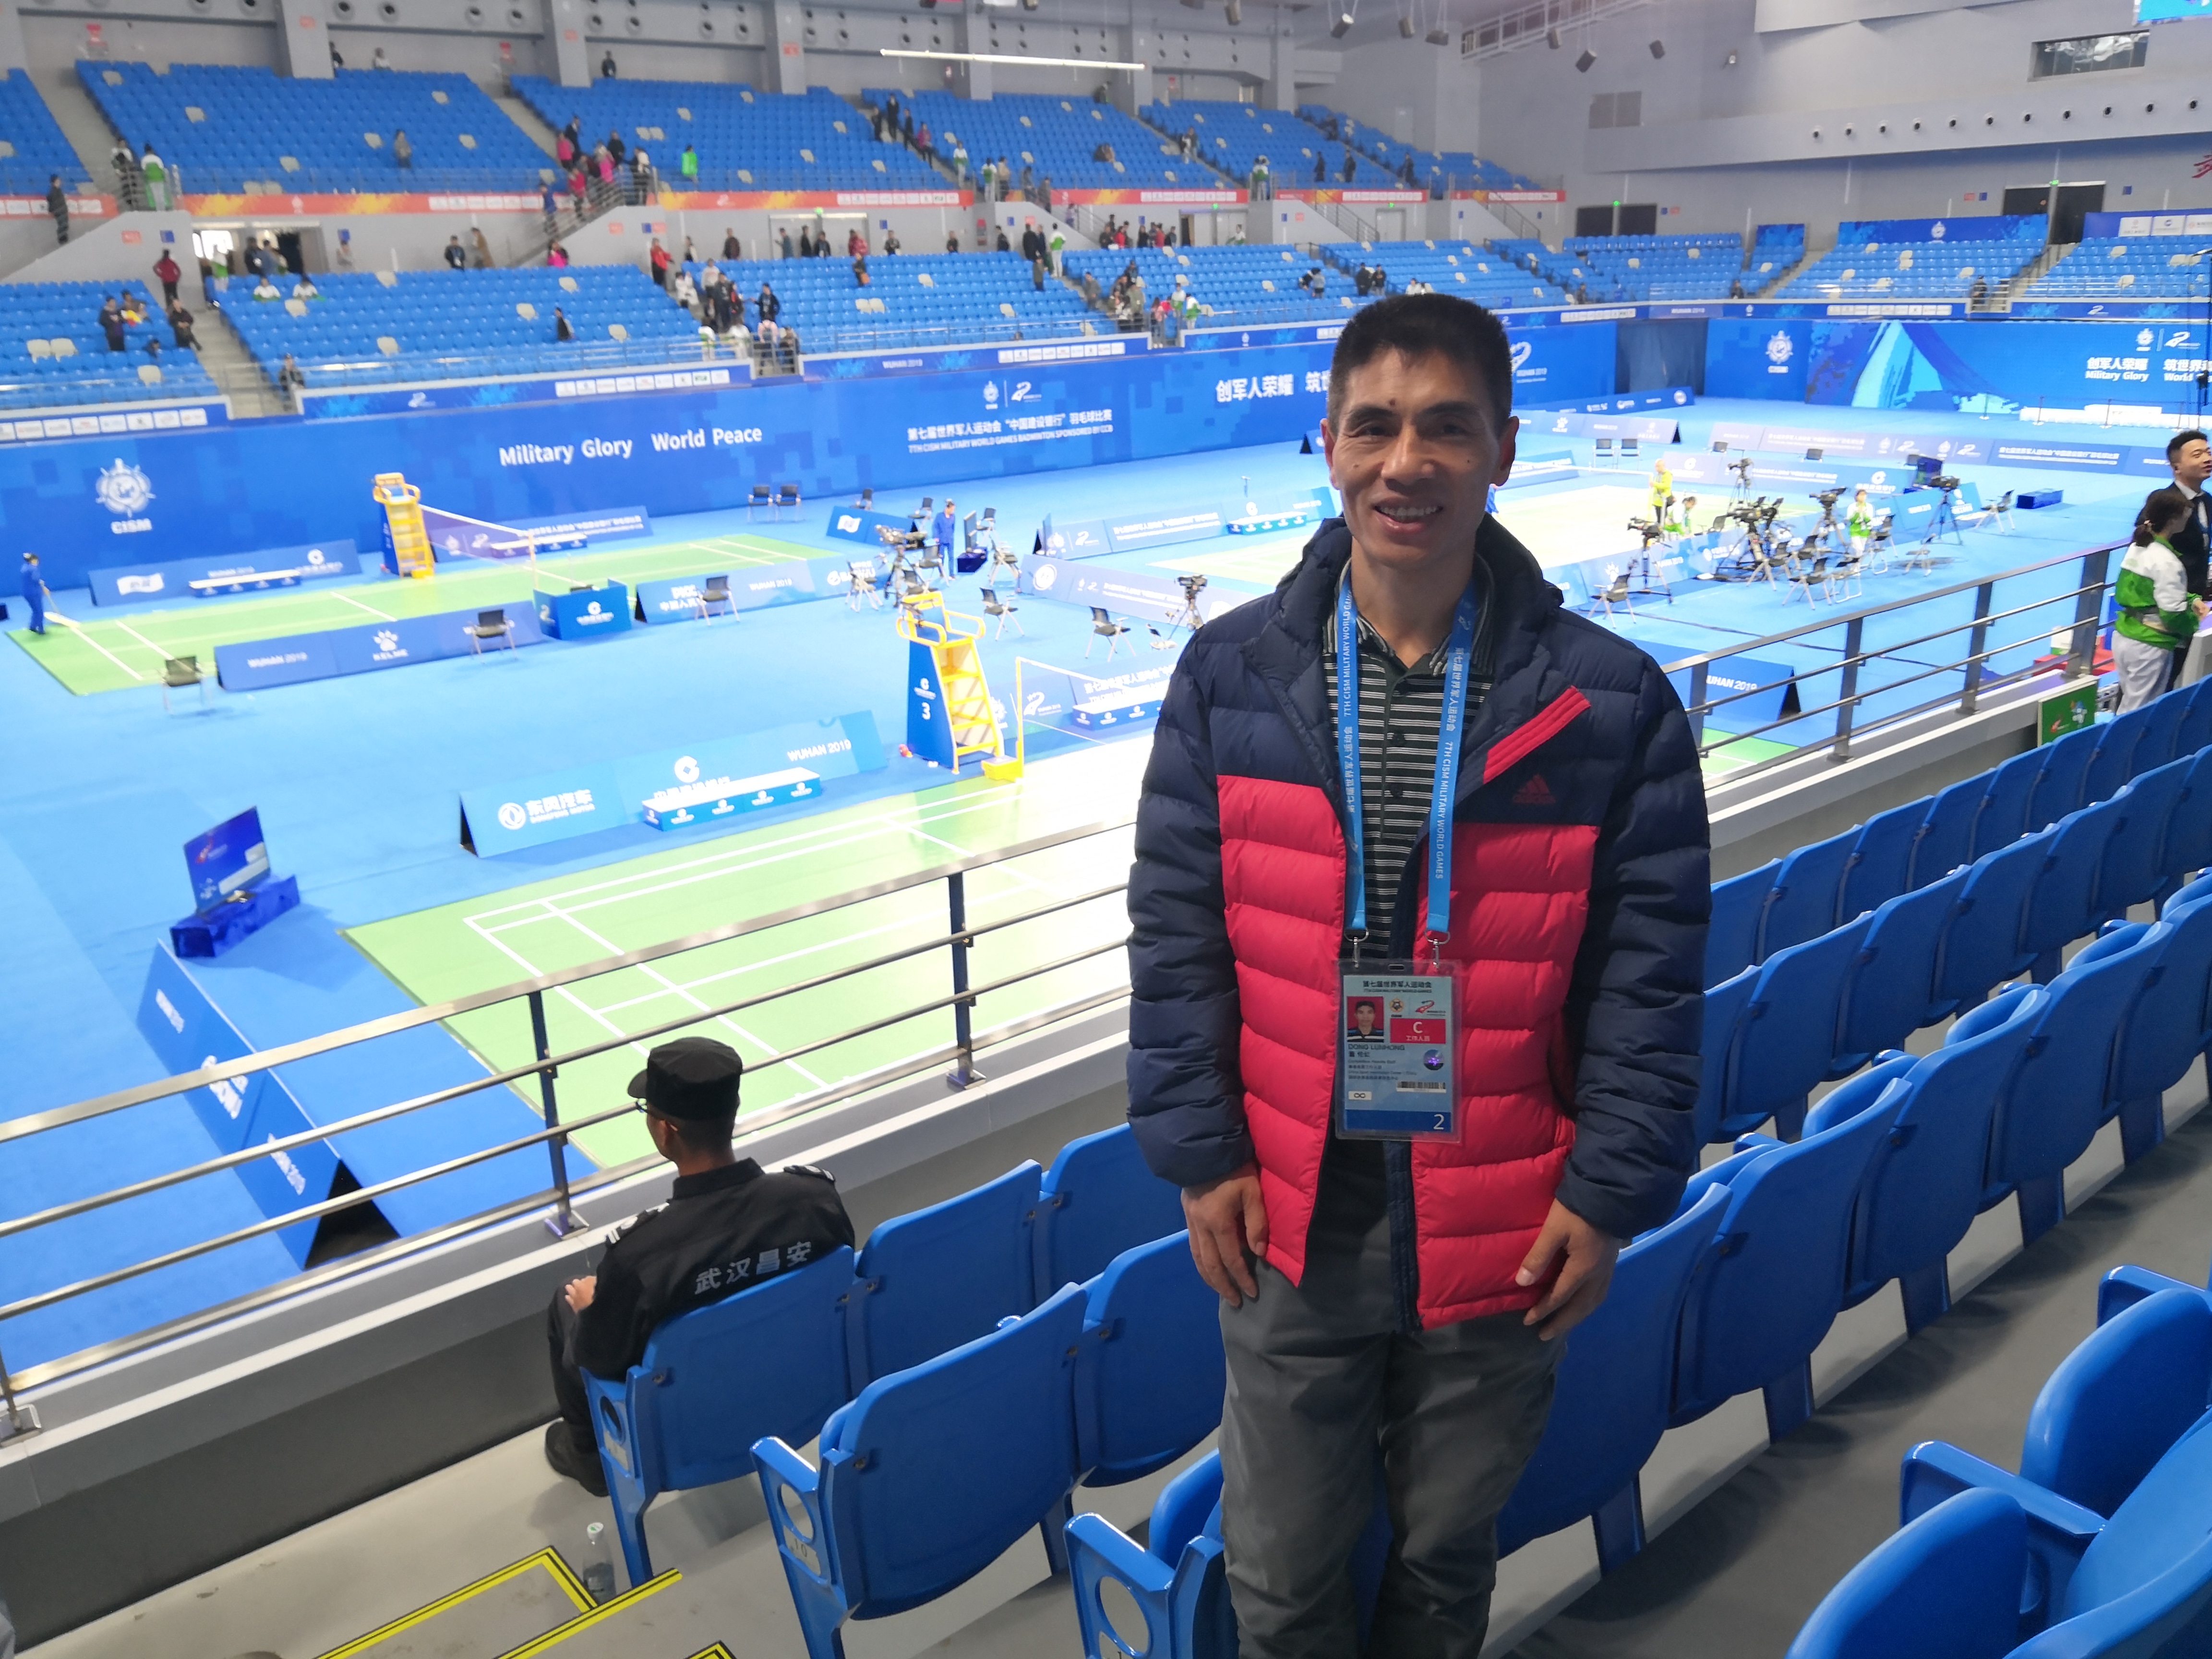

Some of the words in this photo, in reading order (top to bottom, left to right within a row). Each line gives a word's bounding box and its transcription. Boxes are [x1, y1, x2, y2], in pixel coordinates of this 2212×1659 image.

[2085, 371, 2121, 381] Military
[2122, 372, 2150, 383] Glory
[2164, 373, 2194, 382] World
[1215, 373, 1294, 403] 创军人荣耀
[499, 444, 575, 466] Military
[581, 437, 633, 458] Glory
[650, 429, 706, 451] World
[712, 428, 762, 446] Peace
[111, 518, 152, 534] CISM
[247, 655, 284, 668] WUHAN
[1706, 675, 1734, 688] UHAN
[922, 702, 931, 720] 3
[787, 744, 827, 762] WUHAN
[828, 738, 852, 754] 2019
[1445, 742, 1454, 757] 7TH
[1442, 758, 1451, 779] CISM
[525, 789, 594, 817] 东风汽车
[1438, 780, 1449, 818] MILITARY
[1437, 819, 1446, 849] WORLD
[1435, 850, 1444, 879] GAMES
[1413, 1021, 1423, 1034] C
[1433, 1114, 1445, 1130] 2
[695, 1241, 812, 1295] 武汉昌安
